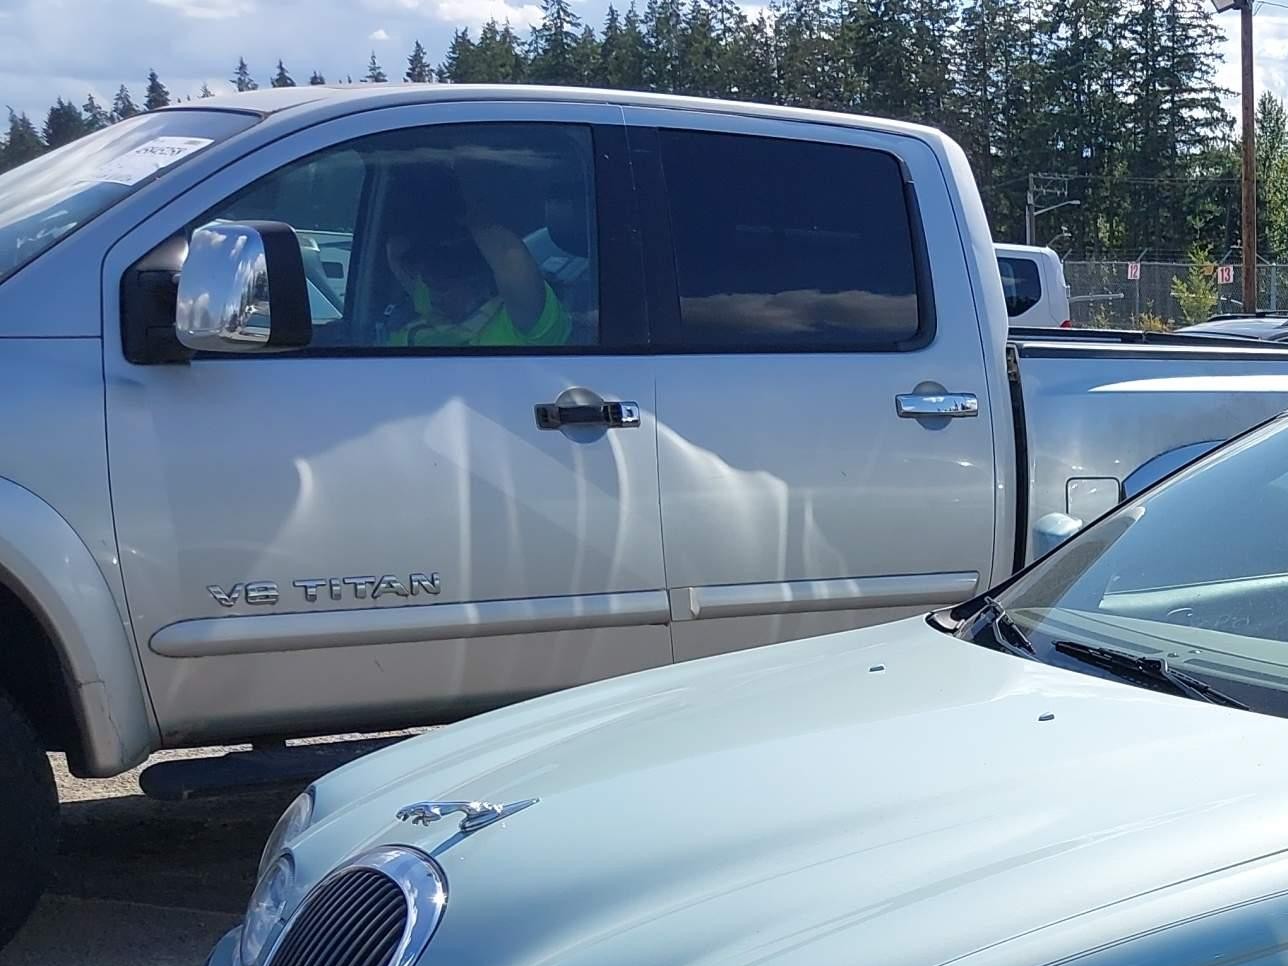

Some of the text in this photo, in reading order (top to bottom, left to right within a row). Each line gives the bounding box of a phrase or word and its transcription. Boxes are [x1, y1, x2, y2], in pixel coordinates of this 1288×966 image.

[1129, 262, 1138, 279] 12
[1220, 267, 1231, 282] 13
[206, 572, 441, 607] V8 TITAN
